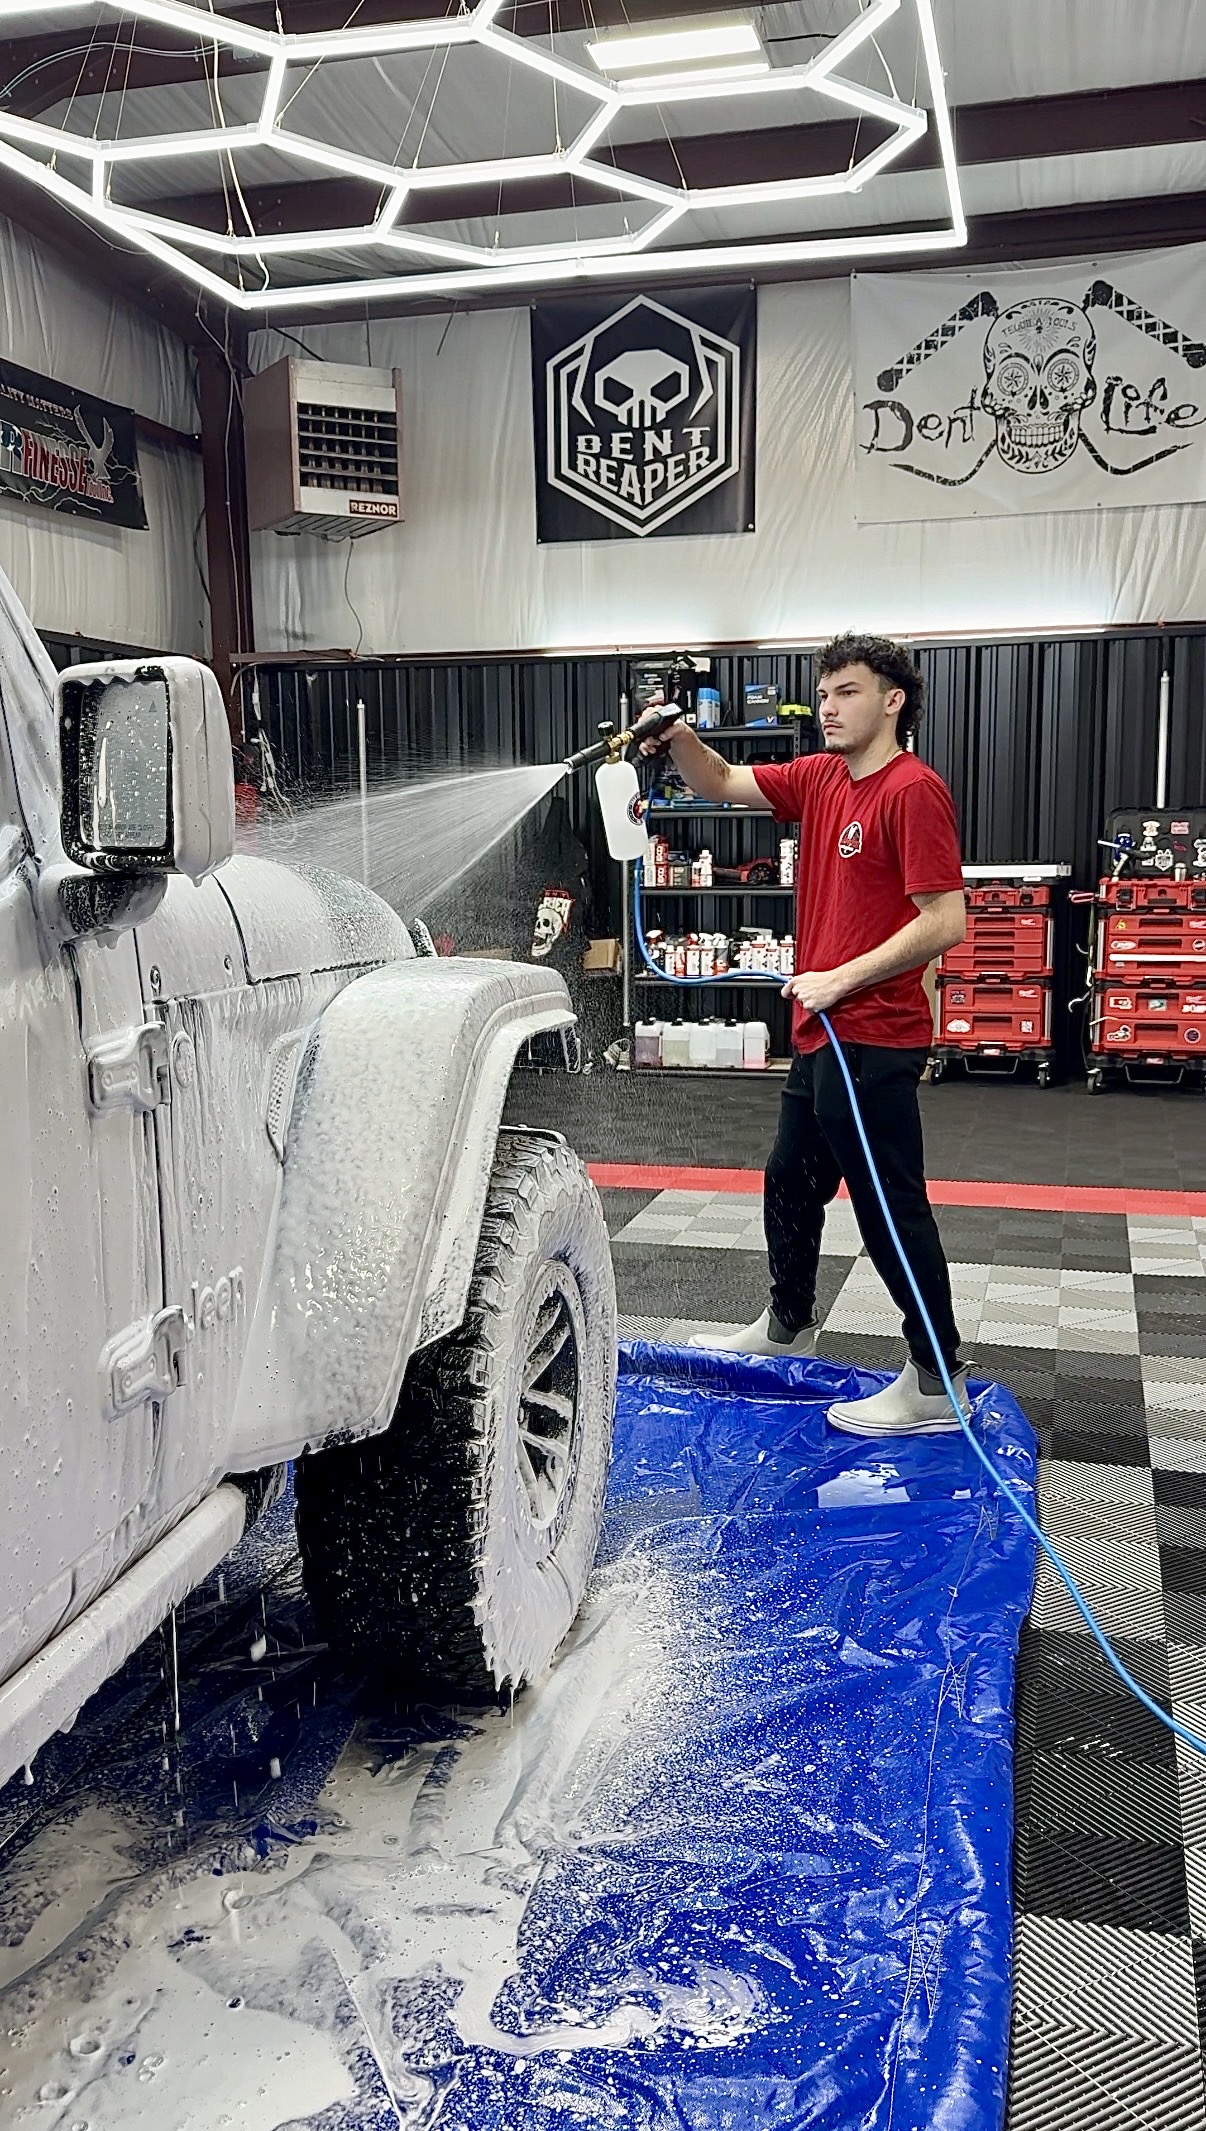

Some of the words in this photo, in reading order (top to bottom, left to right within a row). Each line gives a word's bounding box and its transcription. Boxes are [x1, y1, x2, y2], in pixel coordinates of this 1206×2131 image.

[26, 393, 74, 420] MATTERS
[859, 386, 982, 454] Dent
[1100, 376, 1206, 435] Life
[20, 427, 89, 496] FINESSE
[577, 426, 711, 460] DENT
[575, 446, 712, 506] REAPER
[350, 501, 397, 516] REZNOR
